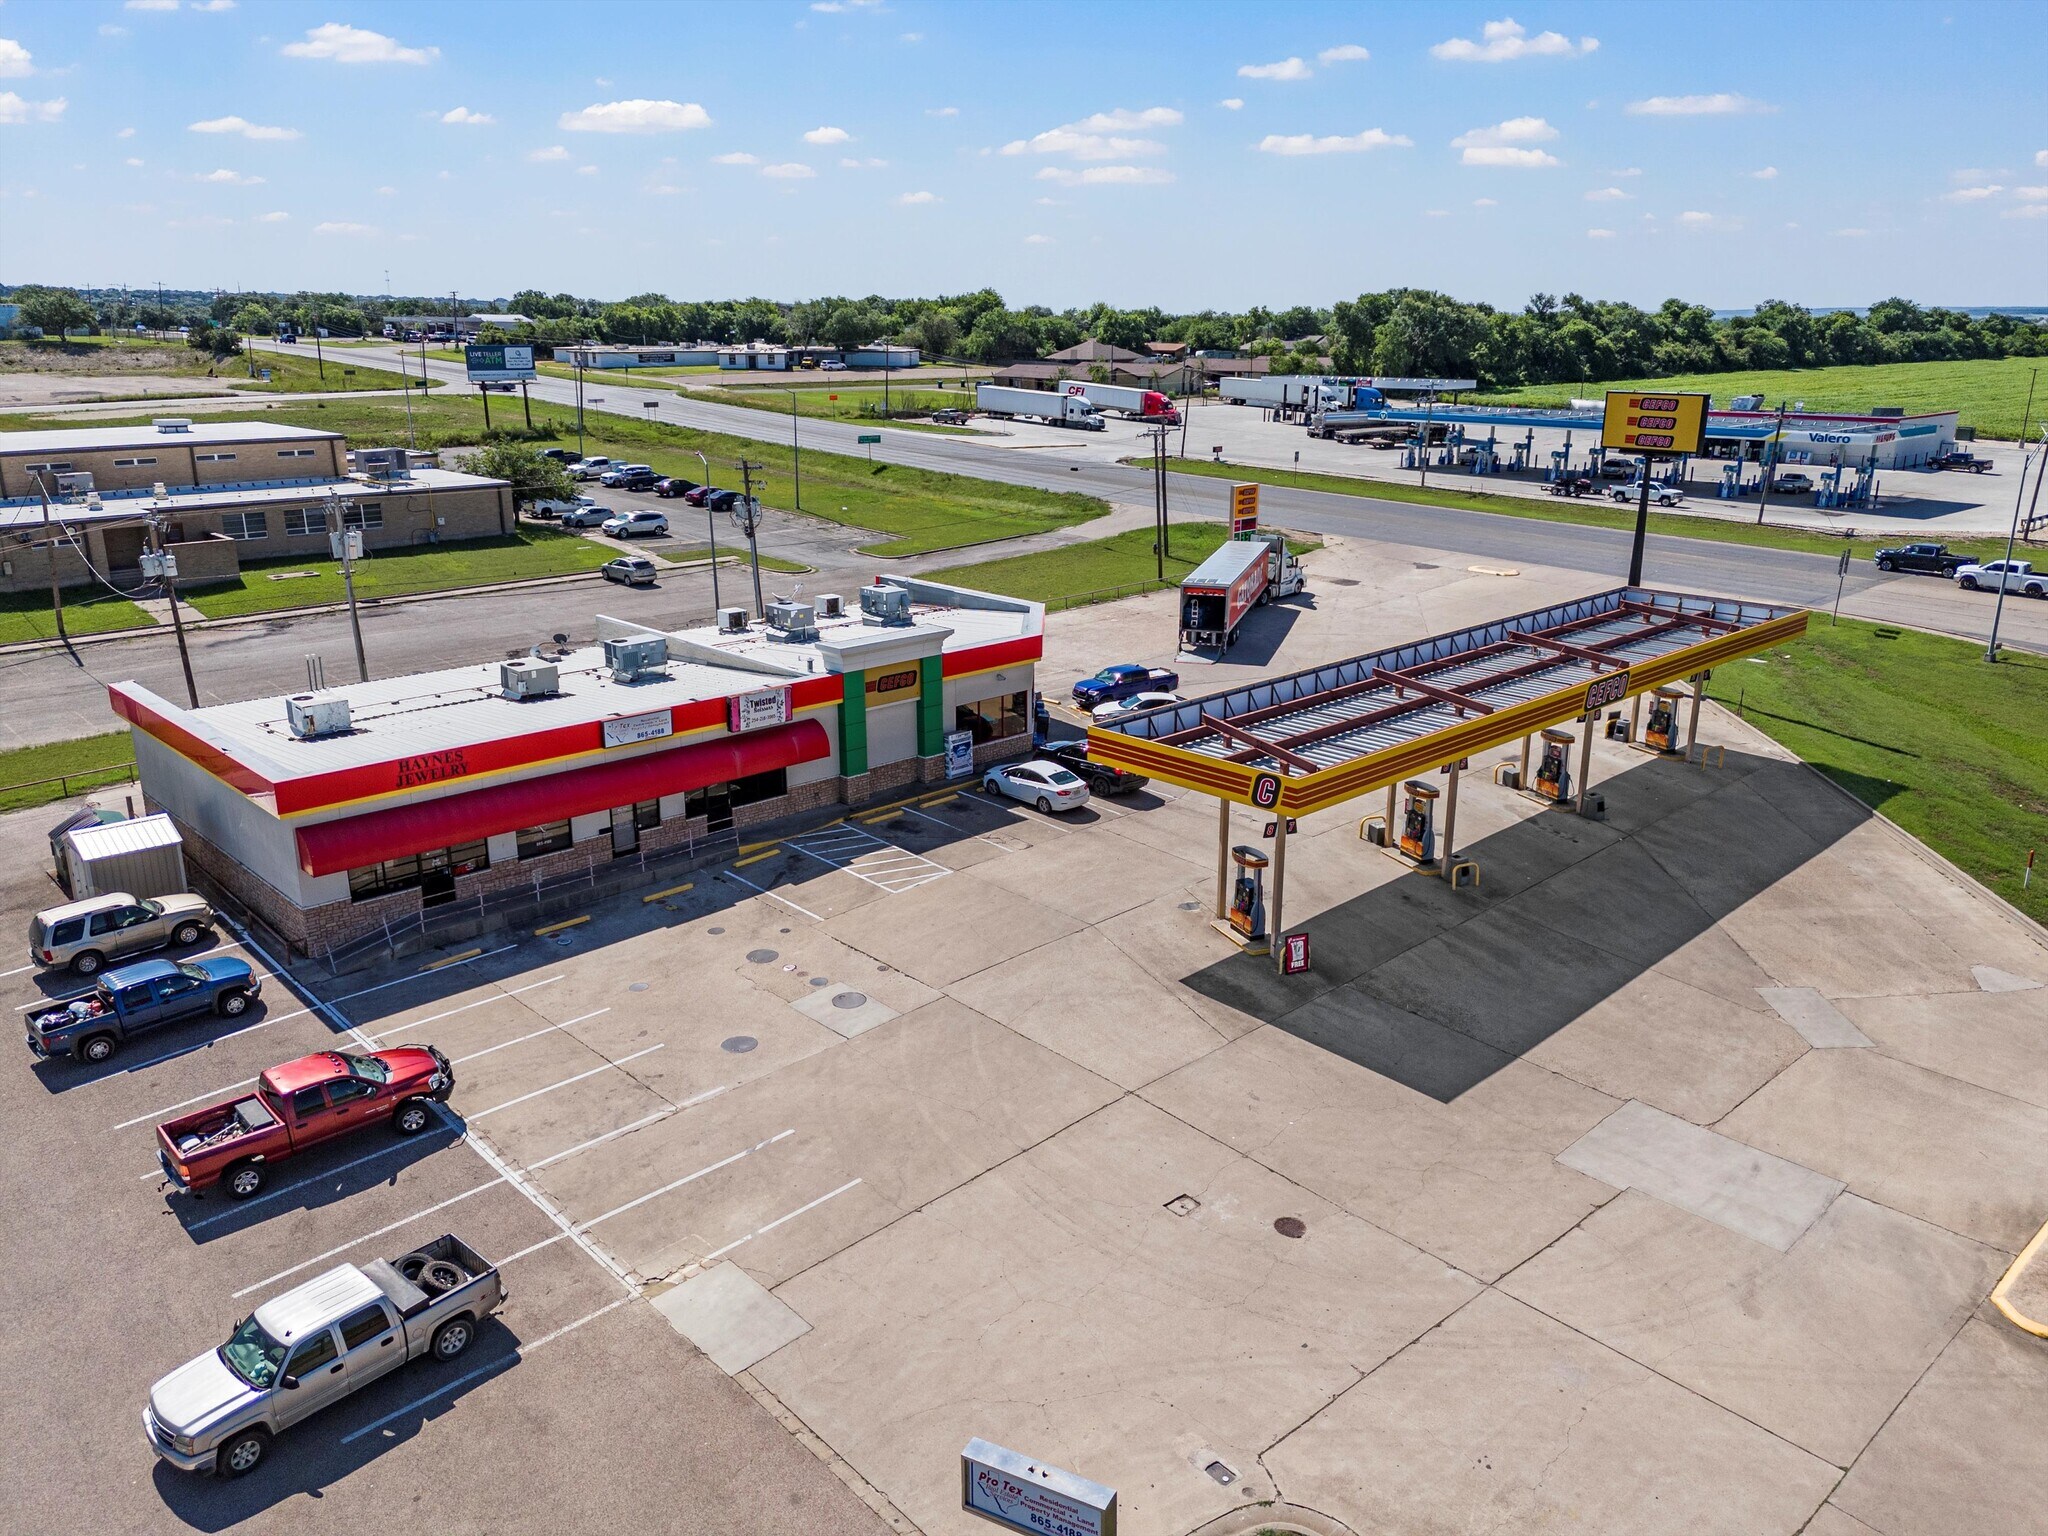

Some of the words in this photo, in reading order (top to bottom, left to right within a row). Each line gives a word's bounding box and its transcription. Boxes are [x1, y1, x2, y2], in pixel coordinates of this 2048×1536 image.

[1068, 386, 1085, 396] CFI
[1642, 399, 1677, 411] CEFCO
[1639, 417, 1675, 429] CEFCO
[1637, 435, 1672, 447] CEFCO
[1809, 433, 1851, 444] Valero
[880, 672, 914, 691] CEFCO
[1586, 674, 1628, 709] CEFCO
[750, 695, 776, 708] Twisted
[637, 728, 664, 739] 865-4188
[398, 750, 464, 773] HAYNES
[396, 763, 467, 788] JEWELRY
[1257, 778, 1275, 804] C
[1266, 824, 1274, 836] 8
[1291, 960, 1304, 969] FREE
[978, 1472, 998, 1486] Pro
[1003, 1481, 1023, 1496] Tex
[1024, 1495, 1066, 1516] Commercial
[1076, 1516, 1095, 1527] Land
[1039, 1495, 1078, 1514] Residential
[1020, 1501, 1051, 1518] Property
[1052, 1513, 1099, 1535] Management
